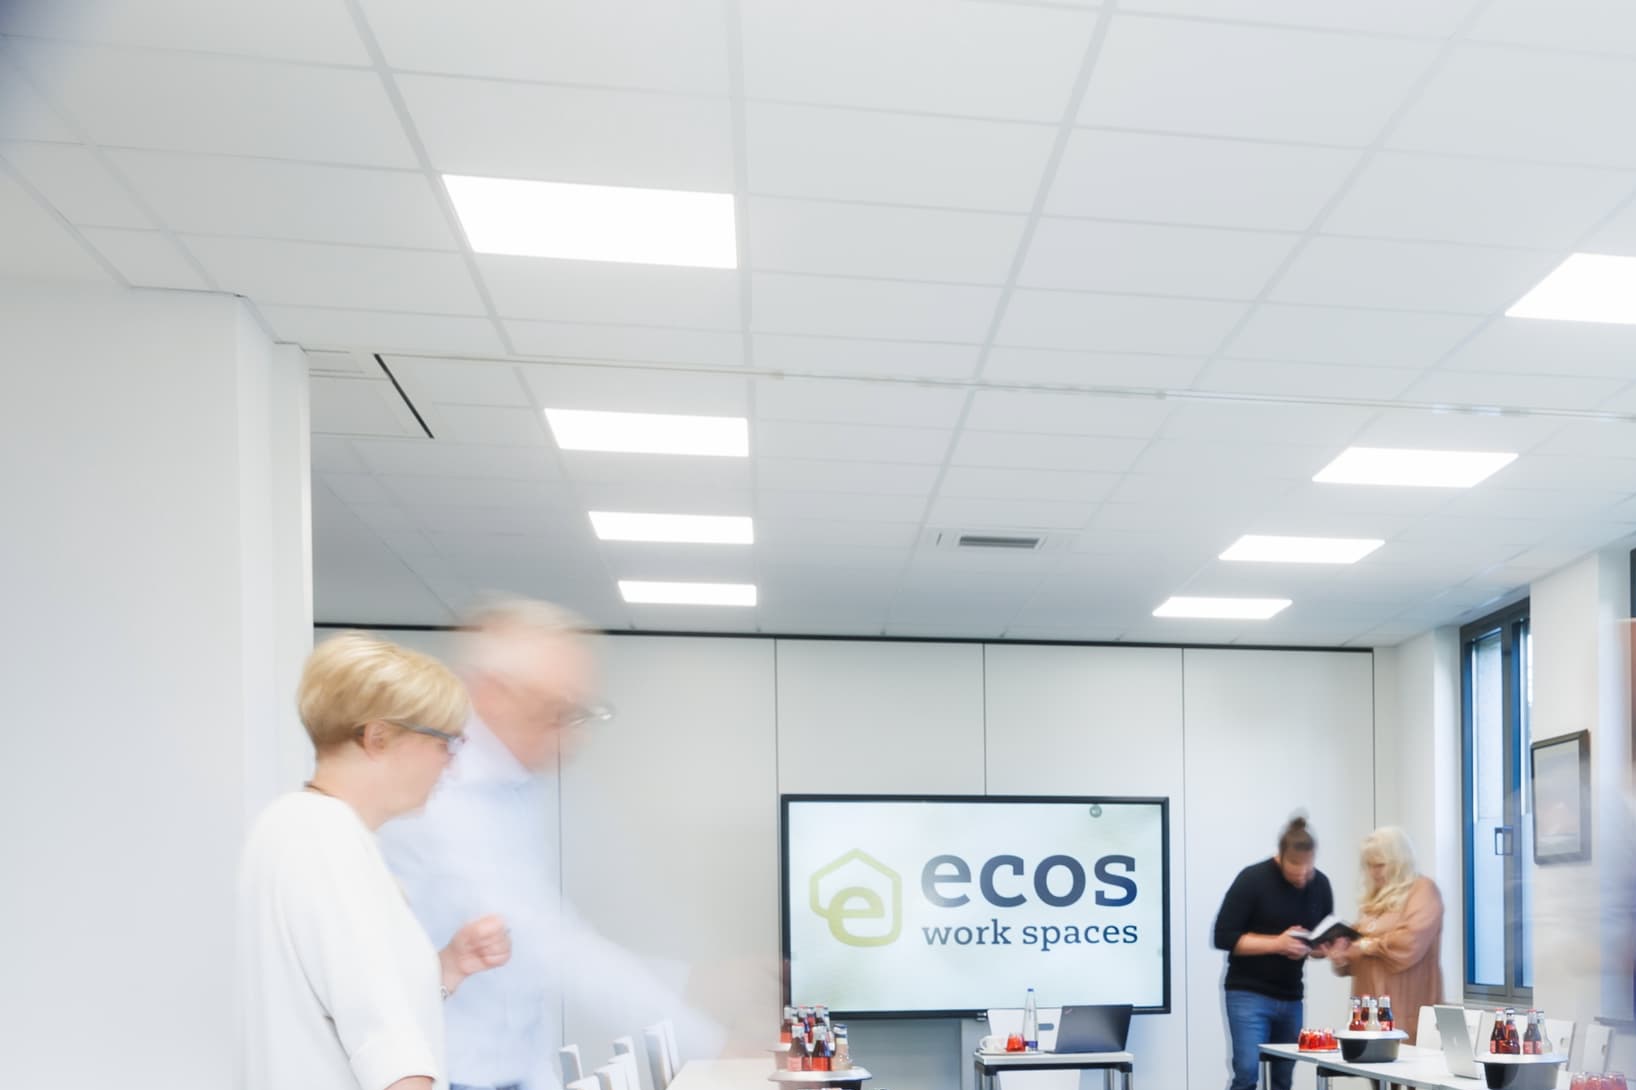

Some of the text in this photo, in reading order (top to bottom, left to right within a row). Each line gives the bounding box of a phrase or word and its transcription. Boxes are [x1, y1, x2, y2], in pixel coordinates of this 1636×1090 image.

[922, 853, 1138, 908] ecos
[922, 918, 1138, 951] work spaces
